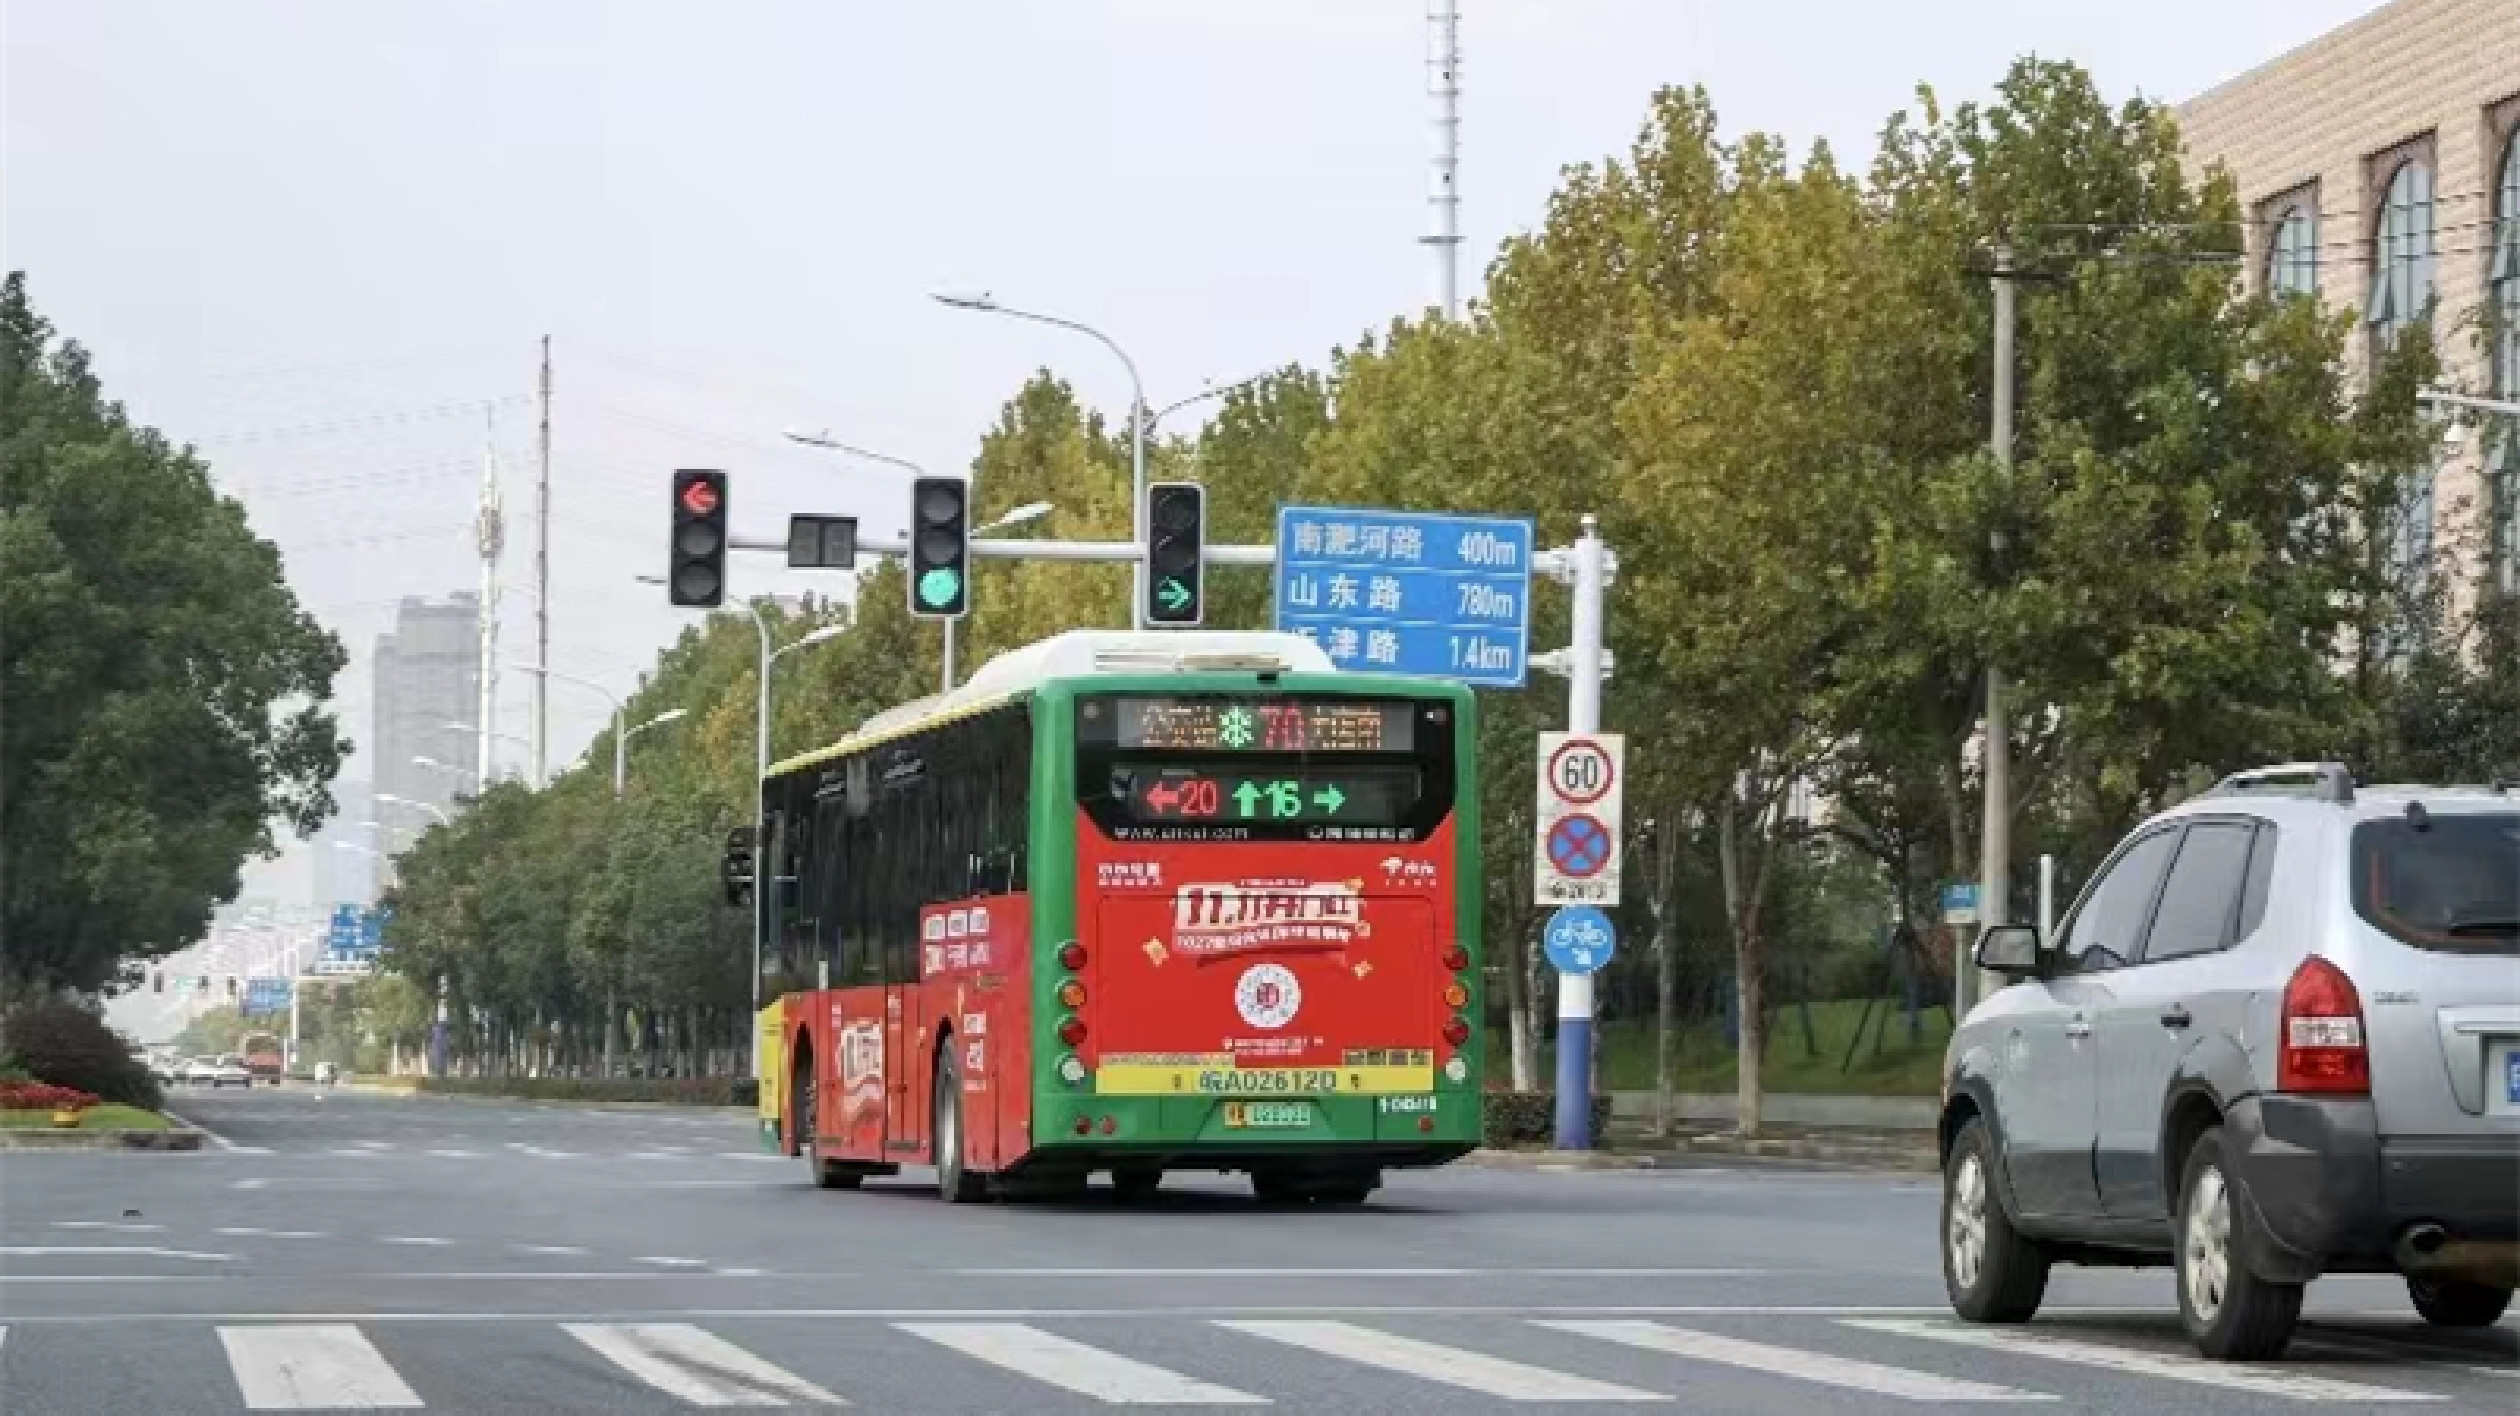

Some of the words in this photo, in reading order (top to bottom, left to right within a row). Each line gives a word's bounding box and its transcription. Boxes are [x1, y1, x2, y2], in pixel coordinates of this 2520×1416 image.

[1458, 531, 1516, 566] 400m
[1288, 573, 1402, 612] 山东路
[1457, 582, 1514, 618] 780m
[1259, 704, 1305, 749] 70
[1564, 755, 1598, 790] 60
[1180, 780, 1219, 816] 20
[1265, 780, 1302, 818] 16
